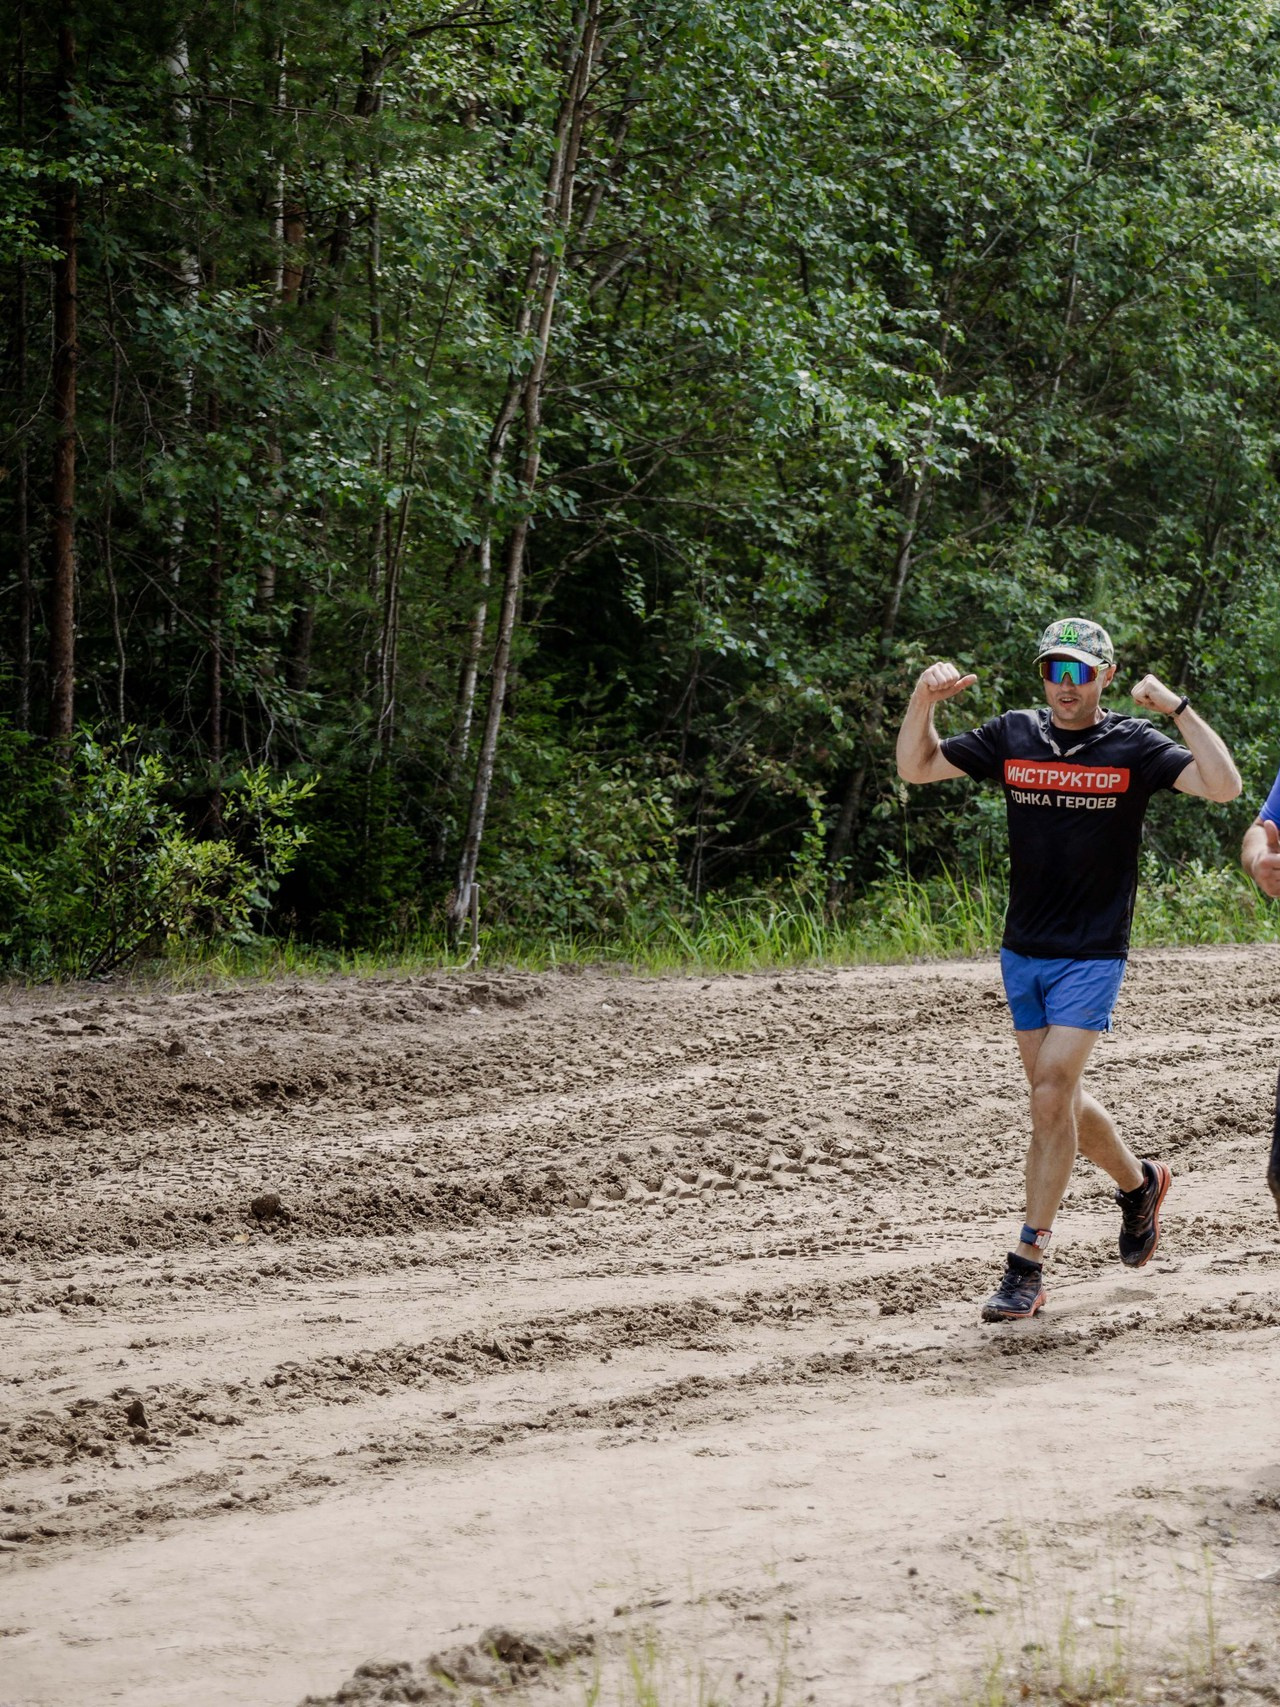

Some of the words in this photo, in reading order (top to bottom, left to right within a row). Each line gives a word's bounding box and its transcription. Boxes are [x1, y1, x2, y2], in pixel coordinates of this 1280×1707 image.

[1060, 622, 1078, 643] LA
[1007, 766, 1121, 788] ИНСТРУКТОР
[1011, 790, 1052, 806] ГОНКА
[1056, 795, 1117, 809] ГЕРОЕВ
